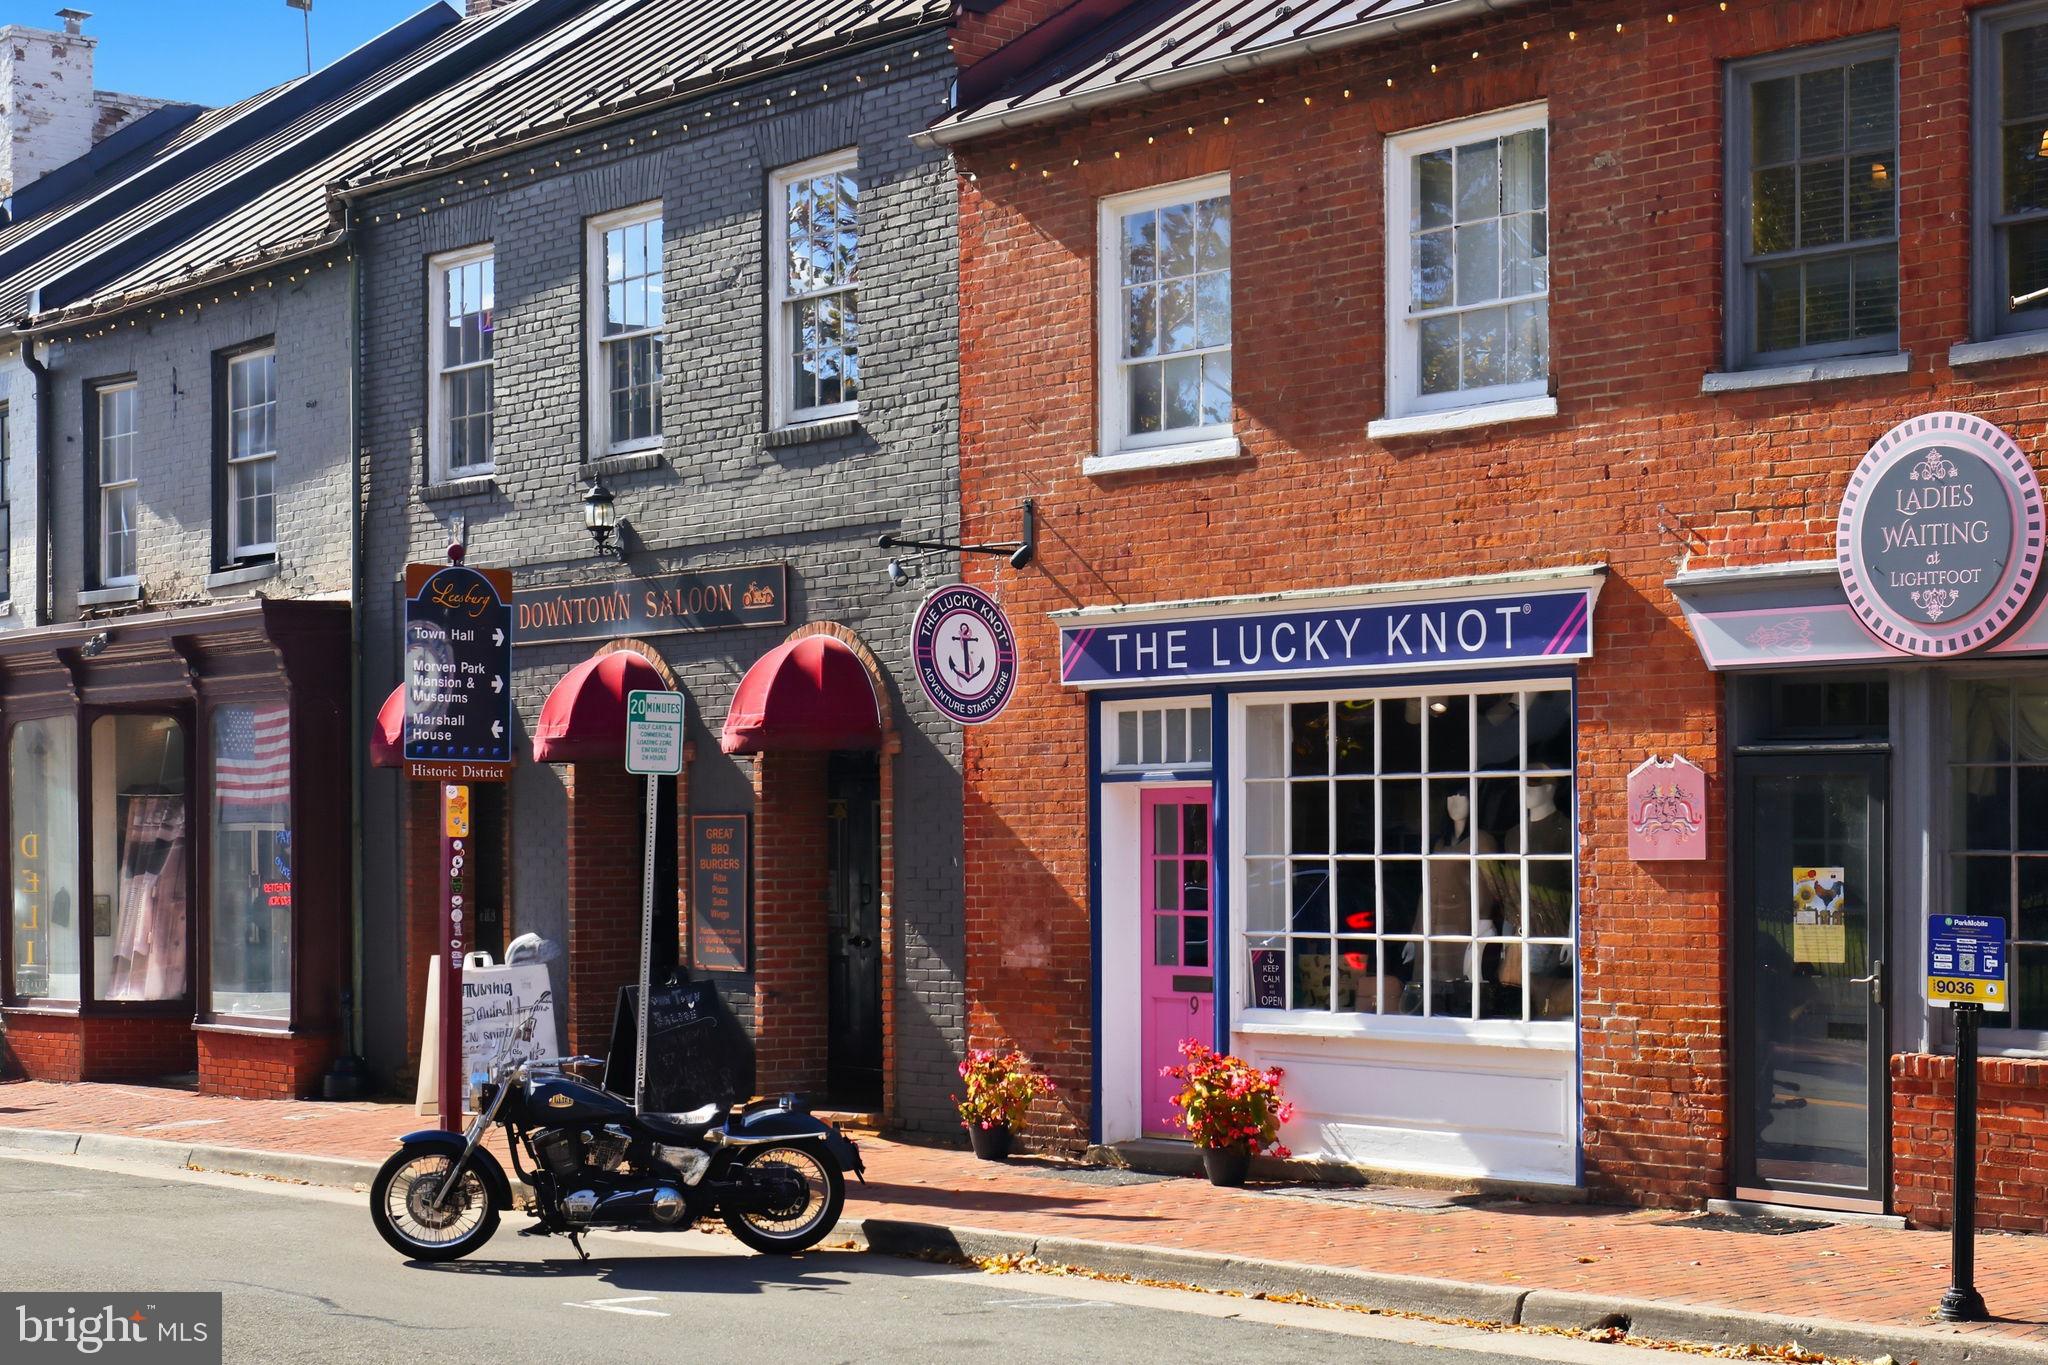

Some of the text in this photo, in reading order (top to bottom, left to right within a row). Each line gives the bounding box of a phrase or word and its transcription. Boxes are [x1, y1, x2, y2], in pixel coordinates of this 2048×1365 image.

[1895, 484, 1973, 515] LADIES
[1881, 519, 1990, 553] WAITING
[1926, 550, 1941, 565] at
[1890, 567, 1982, 587] LIGHTFOOT
[431, 577, 491, 617] Leesburg
[519, 583, 733, 630] DOWNTOWN SALOON
[921, 594, 1007, 643] THE LUCKY KNOT
[414, 626, 474, 641] Town Hall
[1107, 629, 1189, 672] THE
[1212, 618, 1361, 666] LUCKY
[413, 660, 485, 675] Morven Park
[413, 675, 475, 689] Mansion &
[413, 690, 468, 704] Museums
[924, 667, 1009, 715] ADVENTURE STARTS HERE
[630, 699, 680, 714] 20 MINUTES
[413, 712, 465, 726] Marshall
[413, 727, 452, 741] House
[411, 764, 503, 778] Historic District
[706, 828, 734, 840] GREAT
[711, 843, 730, 855] BBQ
[700, 858, 740, 870] BURGERS
[1954, 919, 1988, 927] ParkMobile
[1262, 965, 1279, 973] KEEP
[1262, 975, 1280, 983] CALM
[1937, 980, 1975, 994] 9036
[1190, 995, 1199, 1015] 9
[1261, 996, 1283, 1007] OPEN
